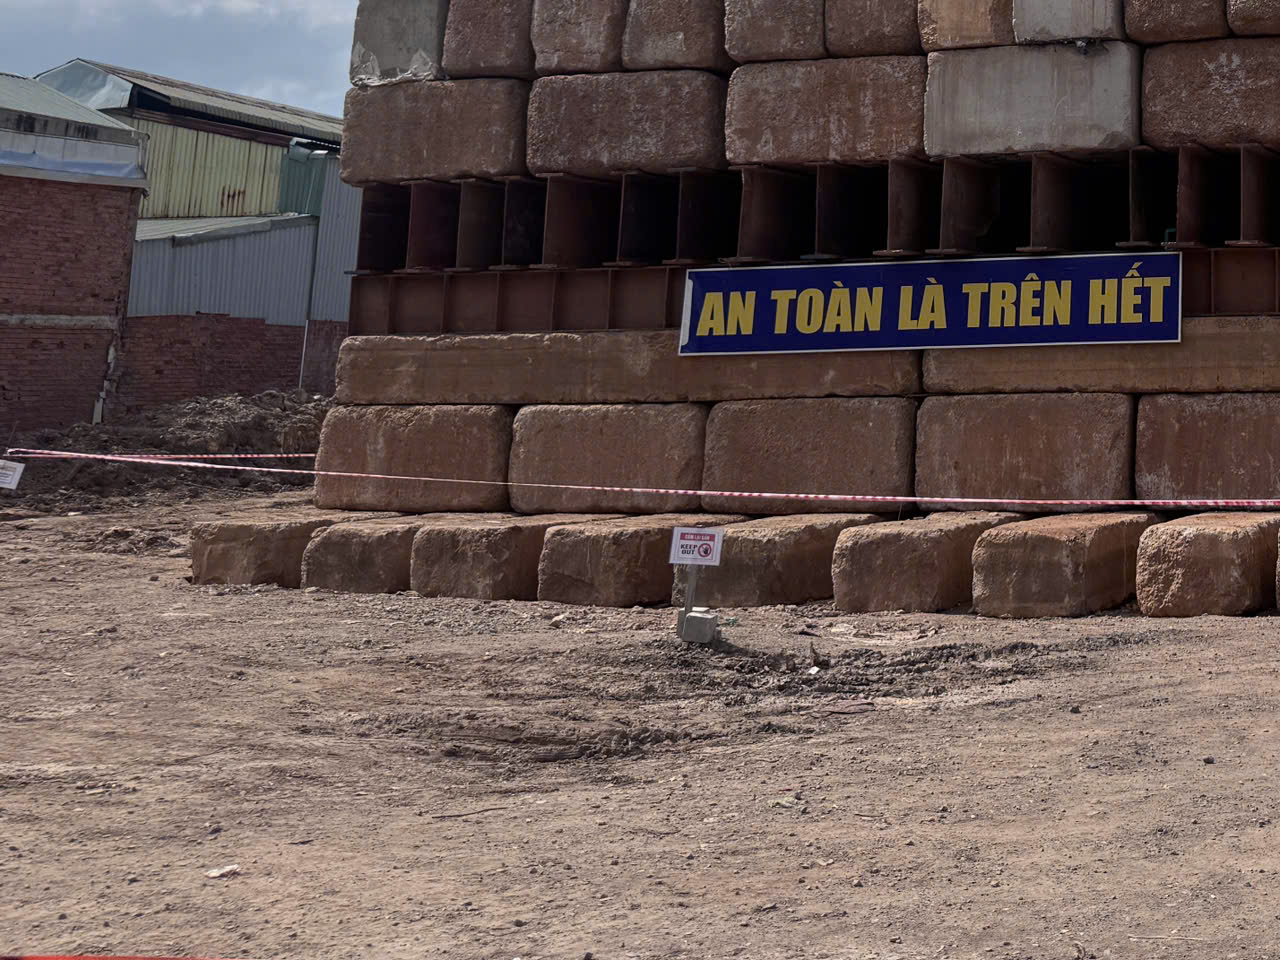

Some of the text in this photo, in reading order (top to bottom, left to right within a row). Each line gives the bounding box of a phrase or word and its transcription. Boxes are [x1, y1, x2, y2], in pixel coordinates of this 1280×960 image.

[696, 261, 1171, 336] AN TOÀN LÀ TRÊN HẾT
